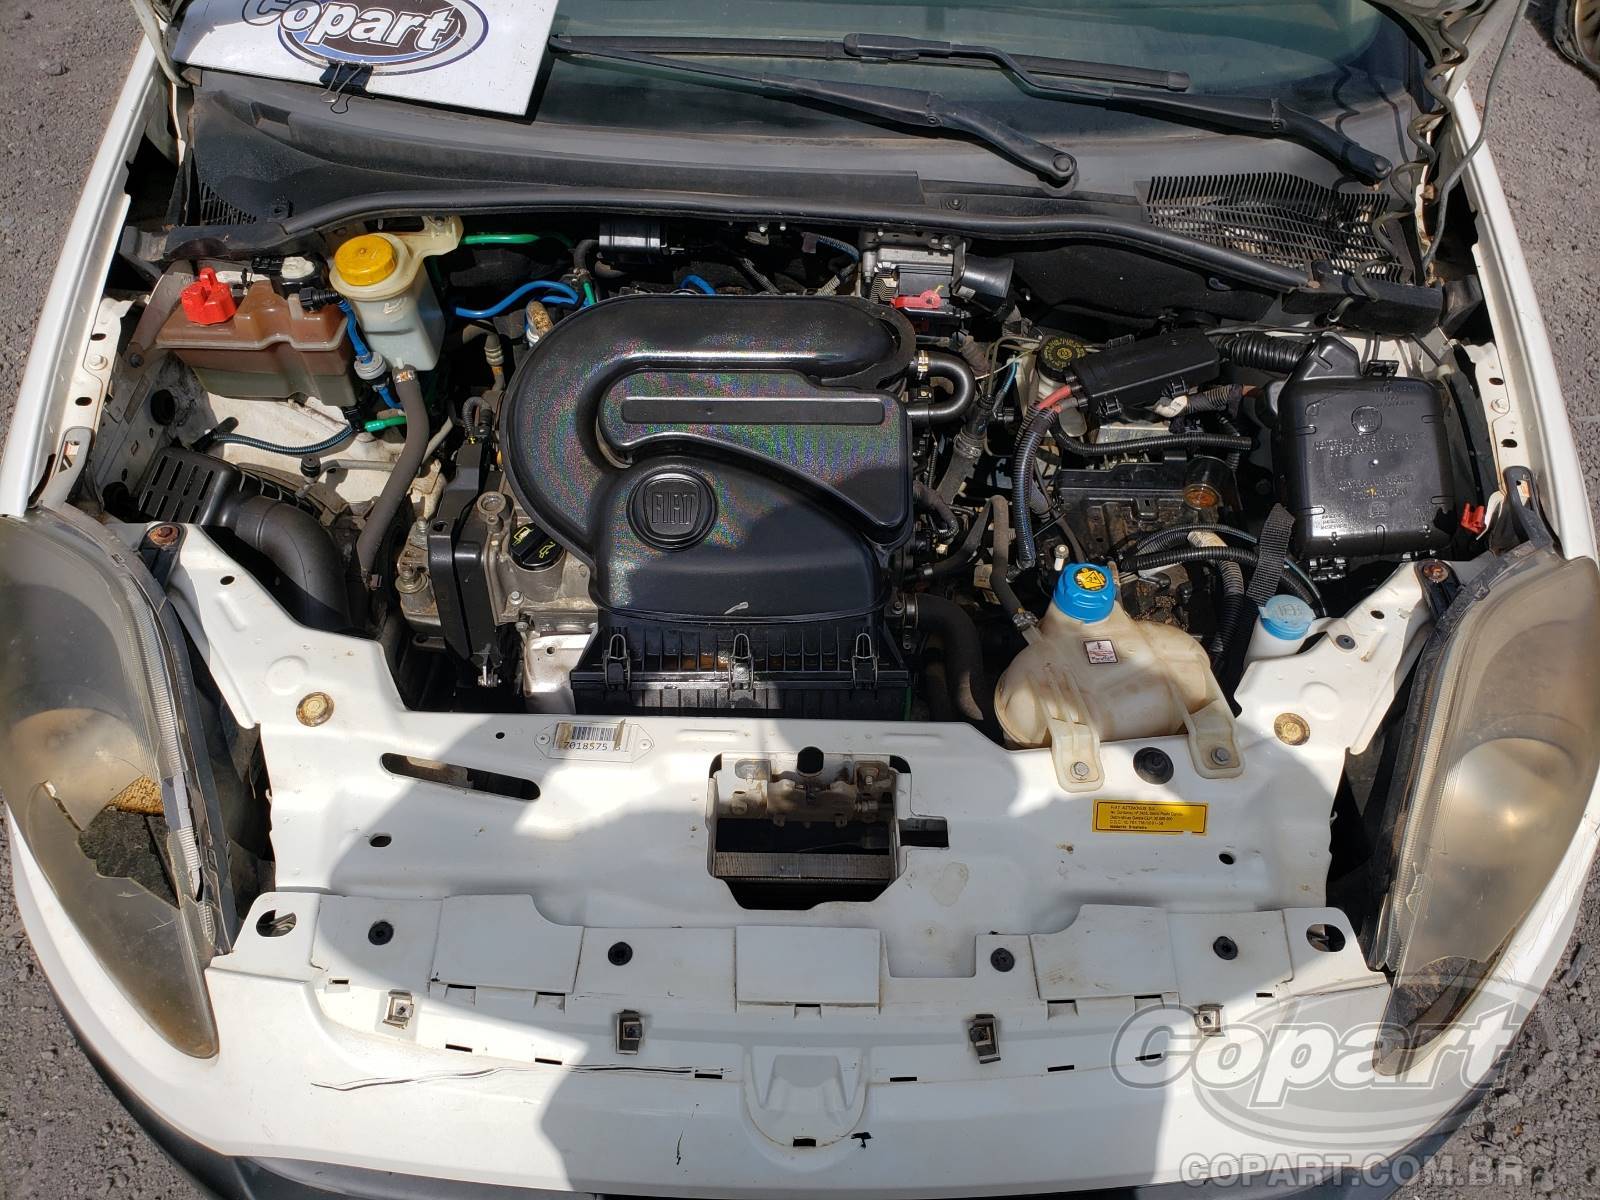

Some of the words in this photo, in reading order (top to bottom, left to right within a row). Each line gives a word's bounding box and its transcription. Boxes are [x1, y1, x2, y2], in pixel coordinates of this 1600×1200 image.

[242, 0, 458, 51] Copart
[651, 491, 697, 524] FIAT
[563, 741, 608, 751] 7018575
